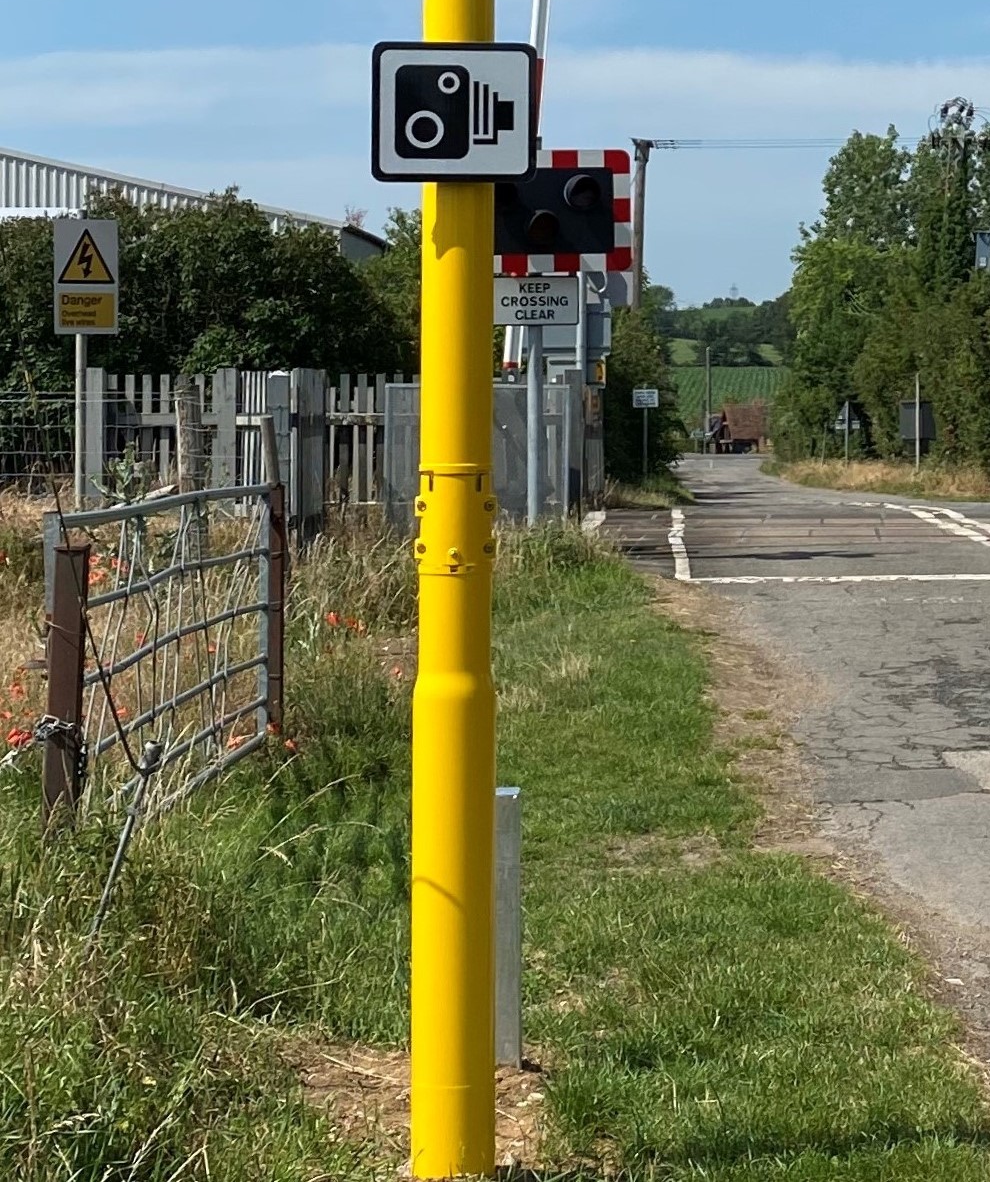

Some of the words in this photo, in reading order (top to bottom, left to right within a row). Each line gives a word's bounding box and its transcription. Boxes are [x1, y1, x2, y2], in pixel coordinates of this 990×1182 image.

[519, 282, 551, 293] KEEP
[62, 294, 103, 307] Danger
[501, 296, 569, 307] CROSSING
[514, 309, 555, 320] CLEAR
